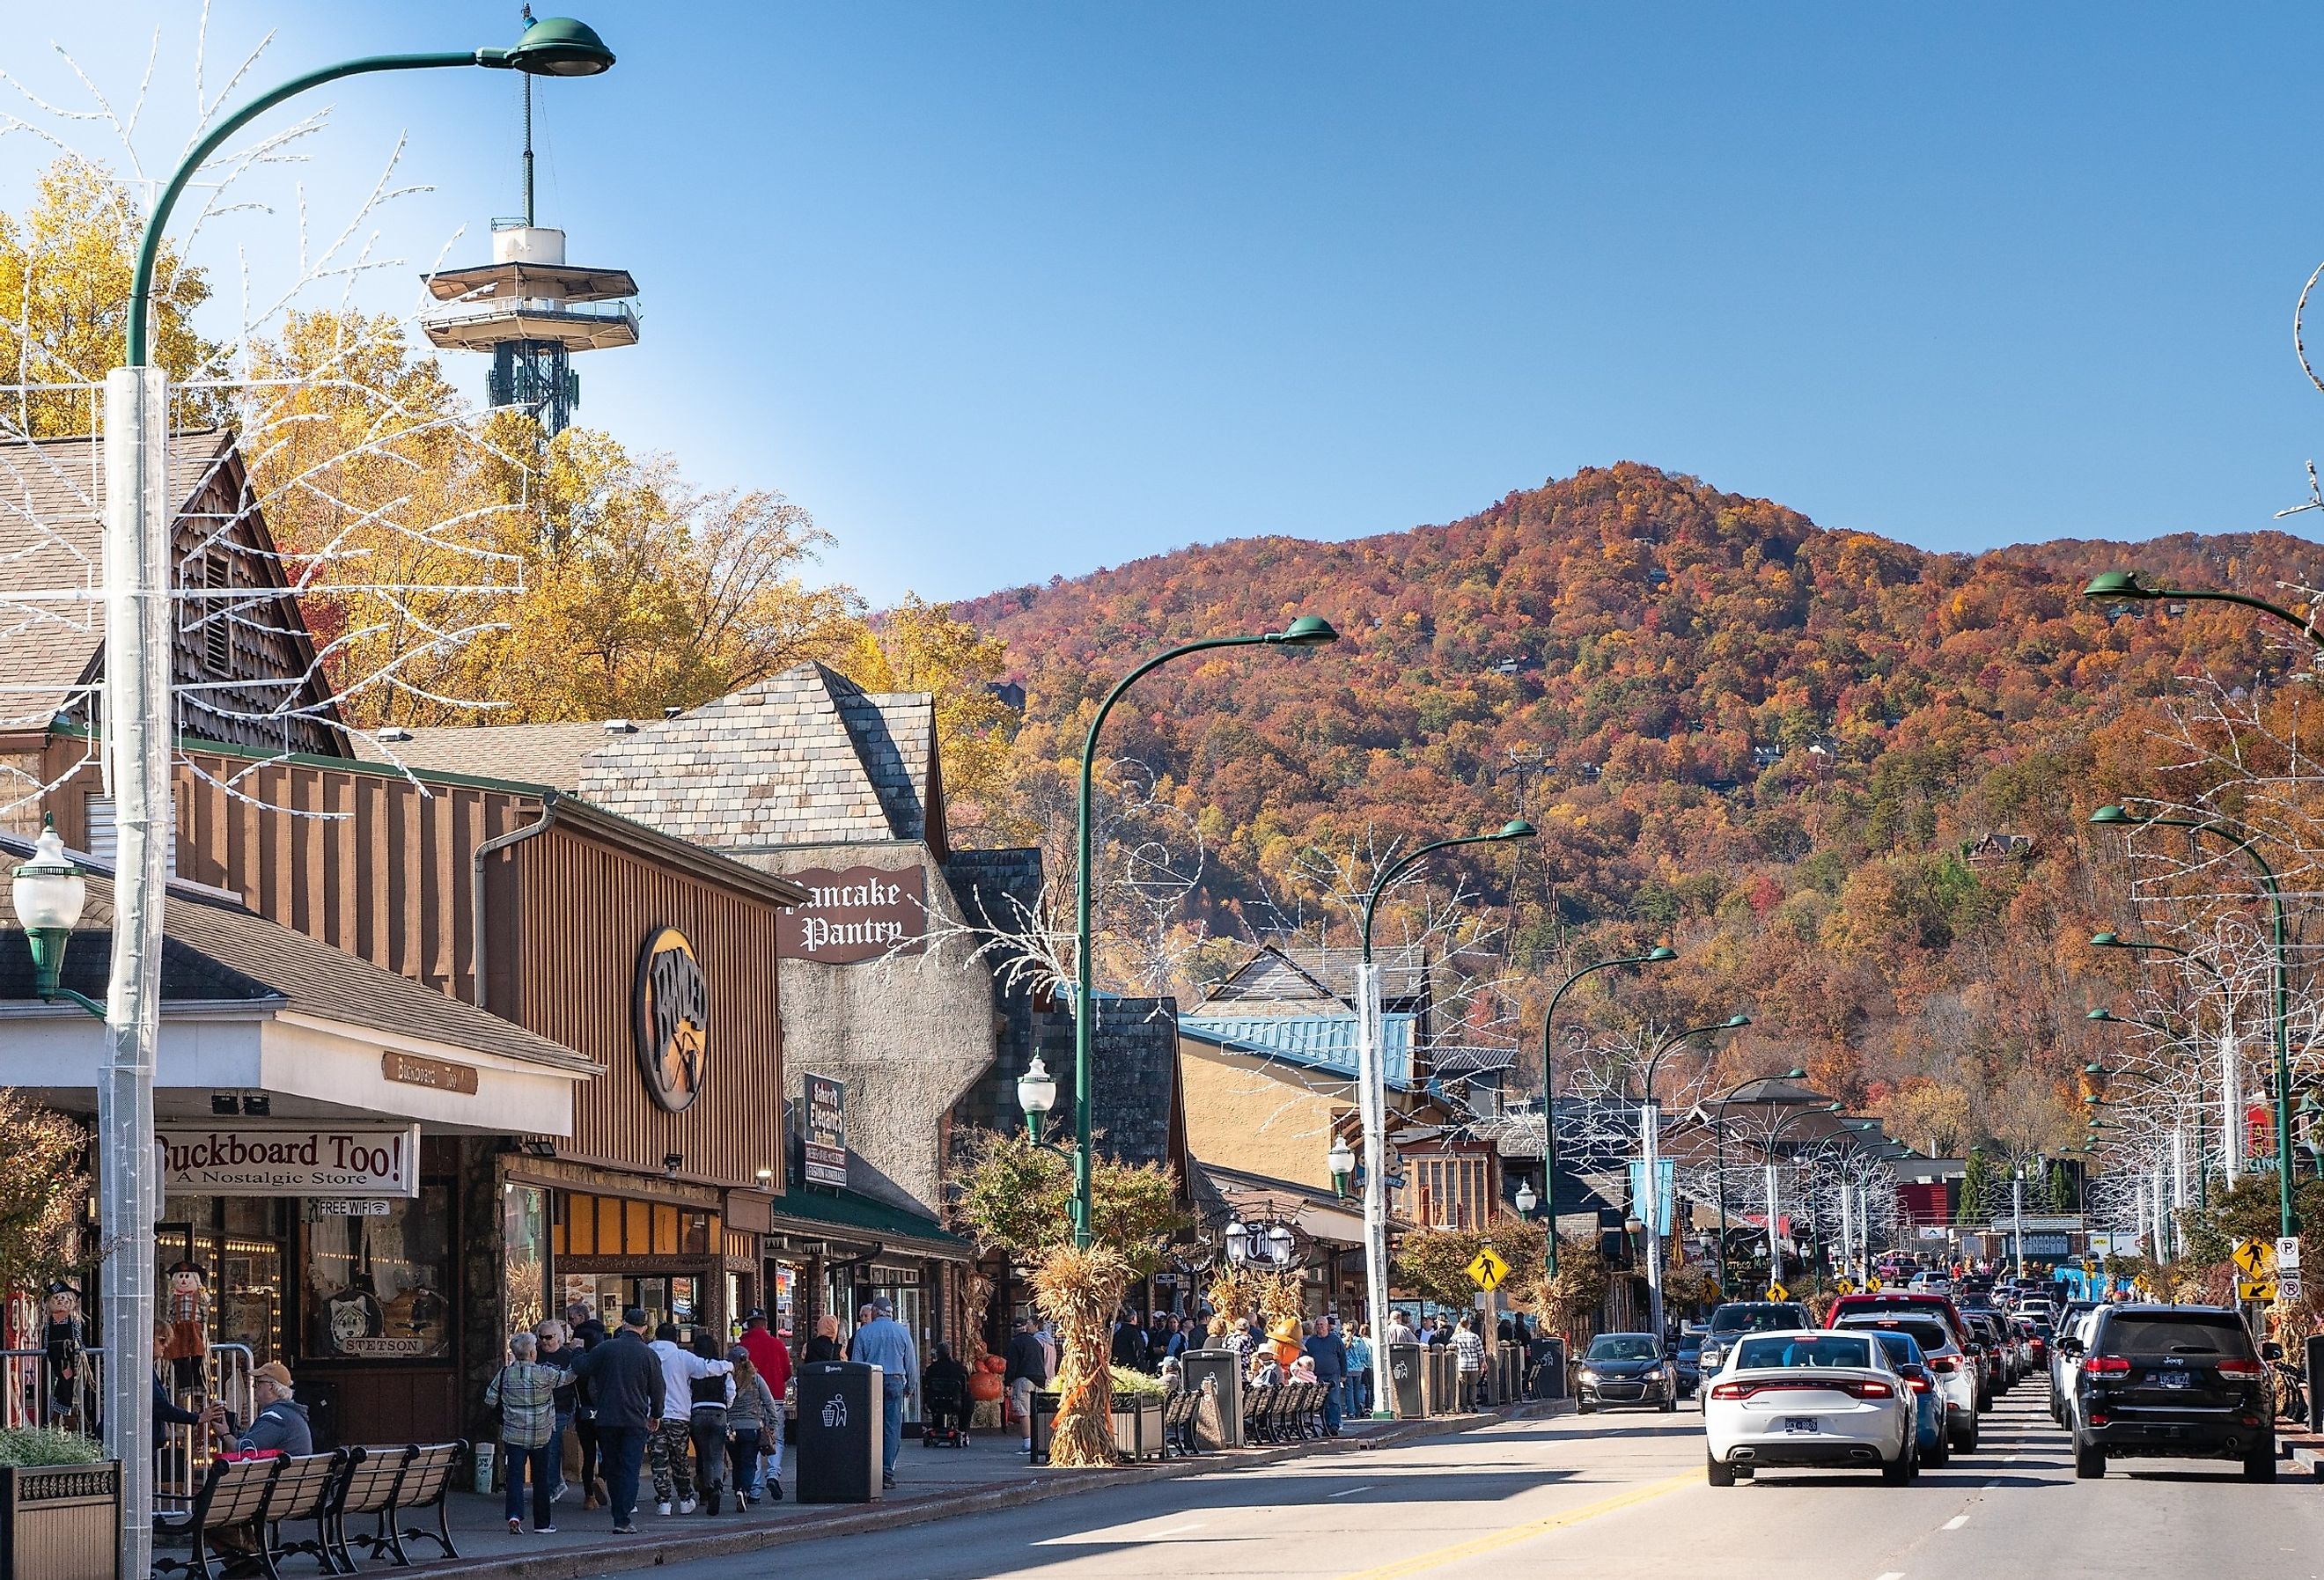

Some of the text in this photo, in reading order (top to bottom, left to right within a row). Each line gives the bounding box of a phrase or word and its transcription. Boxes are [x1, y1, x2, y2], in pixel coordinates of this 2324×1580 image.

[800, 916, 902, 952] Pantry
[329, 1135, 401, 1182] Too!
[177, 1171, 368, 1187] A Nostalgic Store
[320, 1202, 371, 1215] FREE WIFI
[346, 1341, 418, 1351] STETSON
[2163, 1356, 2184, 1366] Jeep
